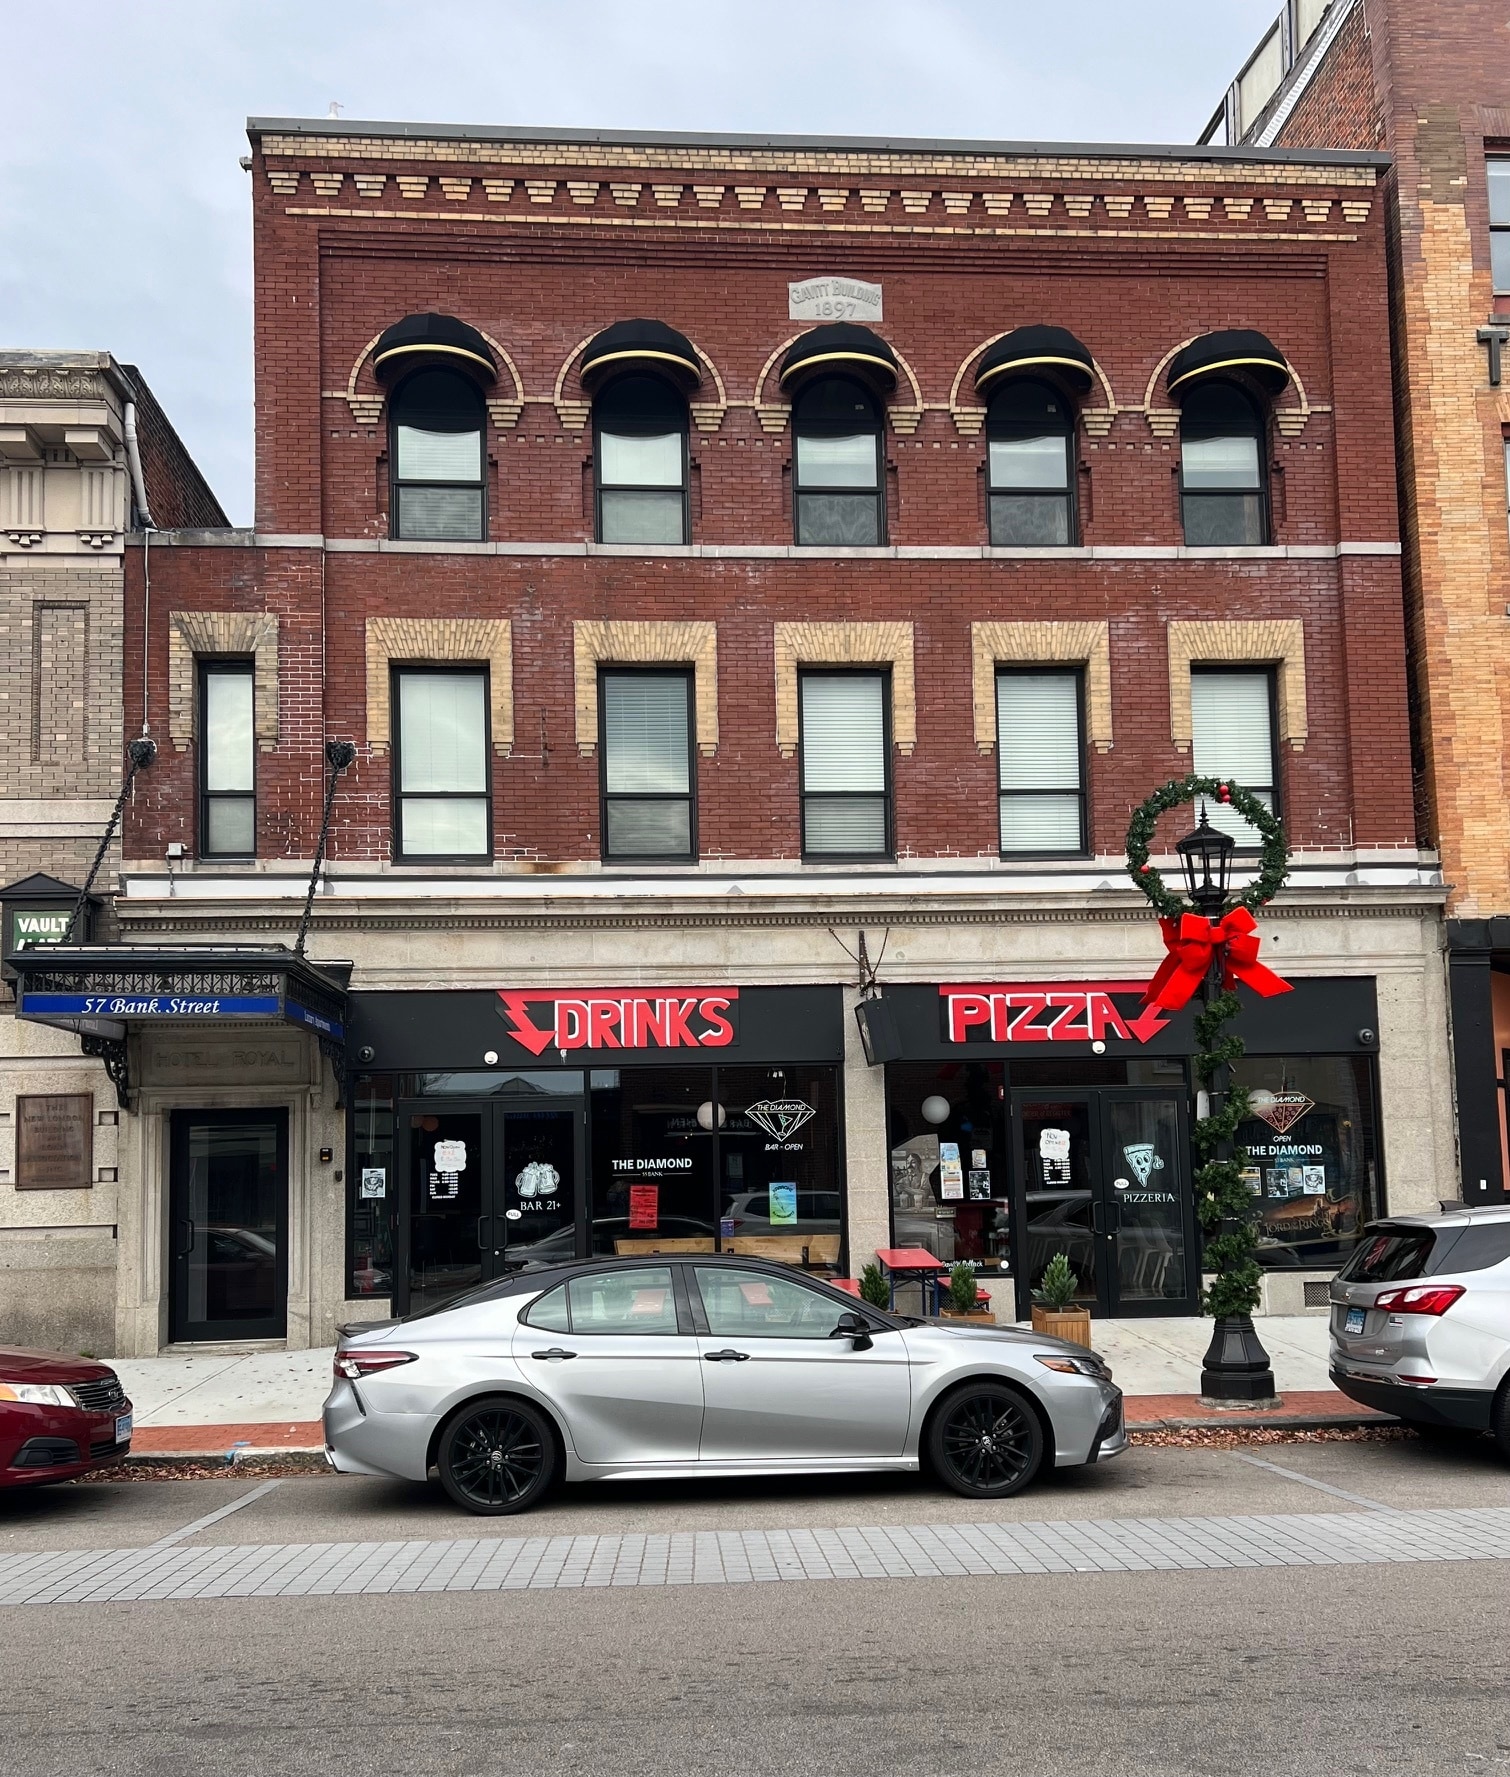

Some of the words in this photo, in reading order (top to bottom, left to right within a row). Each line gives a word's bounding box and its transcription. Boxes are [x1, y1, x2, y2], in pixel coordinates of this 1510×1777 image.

[791, 283, 829, 304] GAVITT
[831, 280, 881, 306] BUILDING
[815, 301, 857, 318] 1897
[17, 917, 70, 933] VAULT
[81, 998, 107, 1013] 57
[166, 998, 220, 1013] Street
[554, 996, 735, 1049] DRINKS
[947, 992, 1133, 1042] PIZZA
[156, 1051, 218, 1067] HOTEL
[232, 1050, 295, 1067] ROYAL
[1273, 1135, 1292, 1143] OPEN
[764, 1143, 779, 1151] BAR
[784, 1143, 804, 1151] OPEN
[1245, 1145, 1267, 1156] THE
[1268, 1144, 1323, 1155] DIAMOND
[612, 1159, 635, 1170] THE
[636, 1158, 693, 1170] DIAMOND
[520, 1201, 543, 1211] BAR
[546, 1200, 562, 1210] 21+
[1123, 1193, 1175, 1203] PIZZERIA
[1263, 1222, 1290, 1237] LORD
